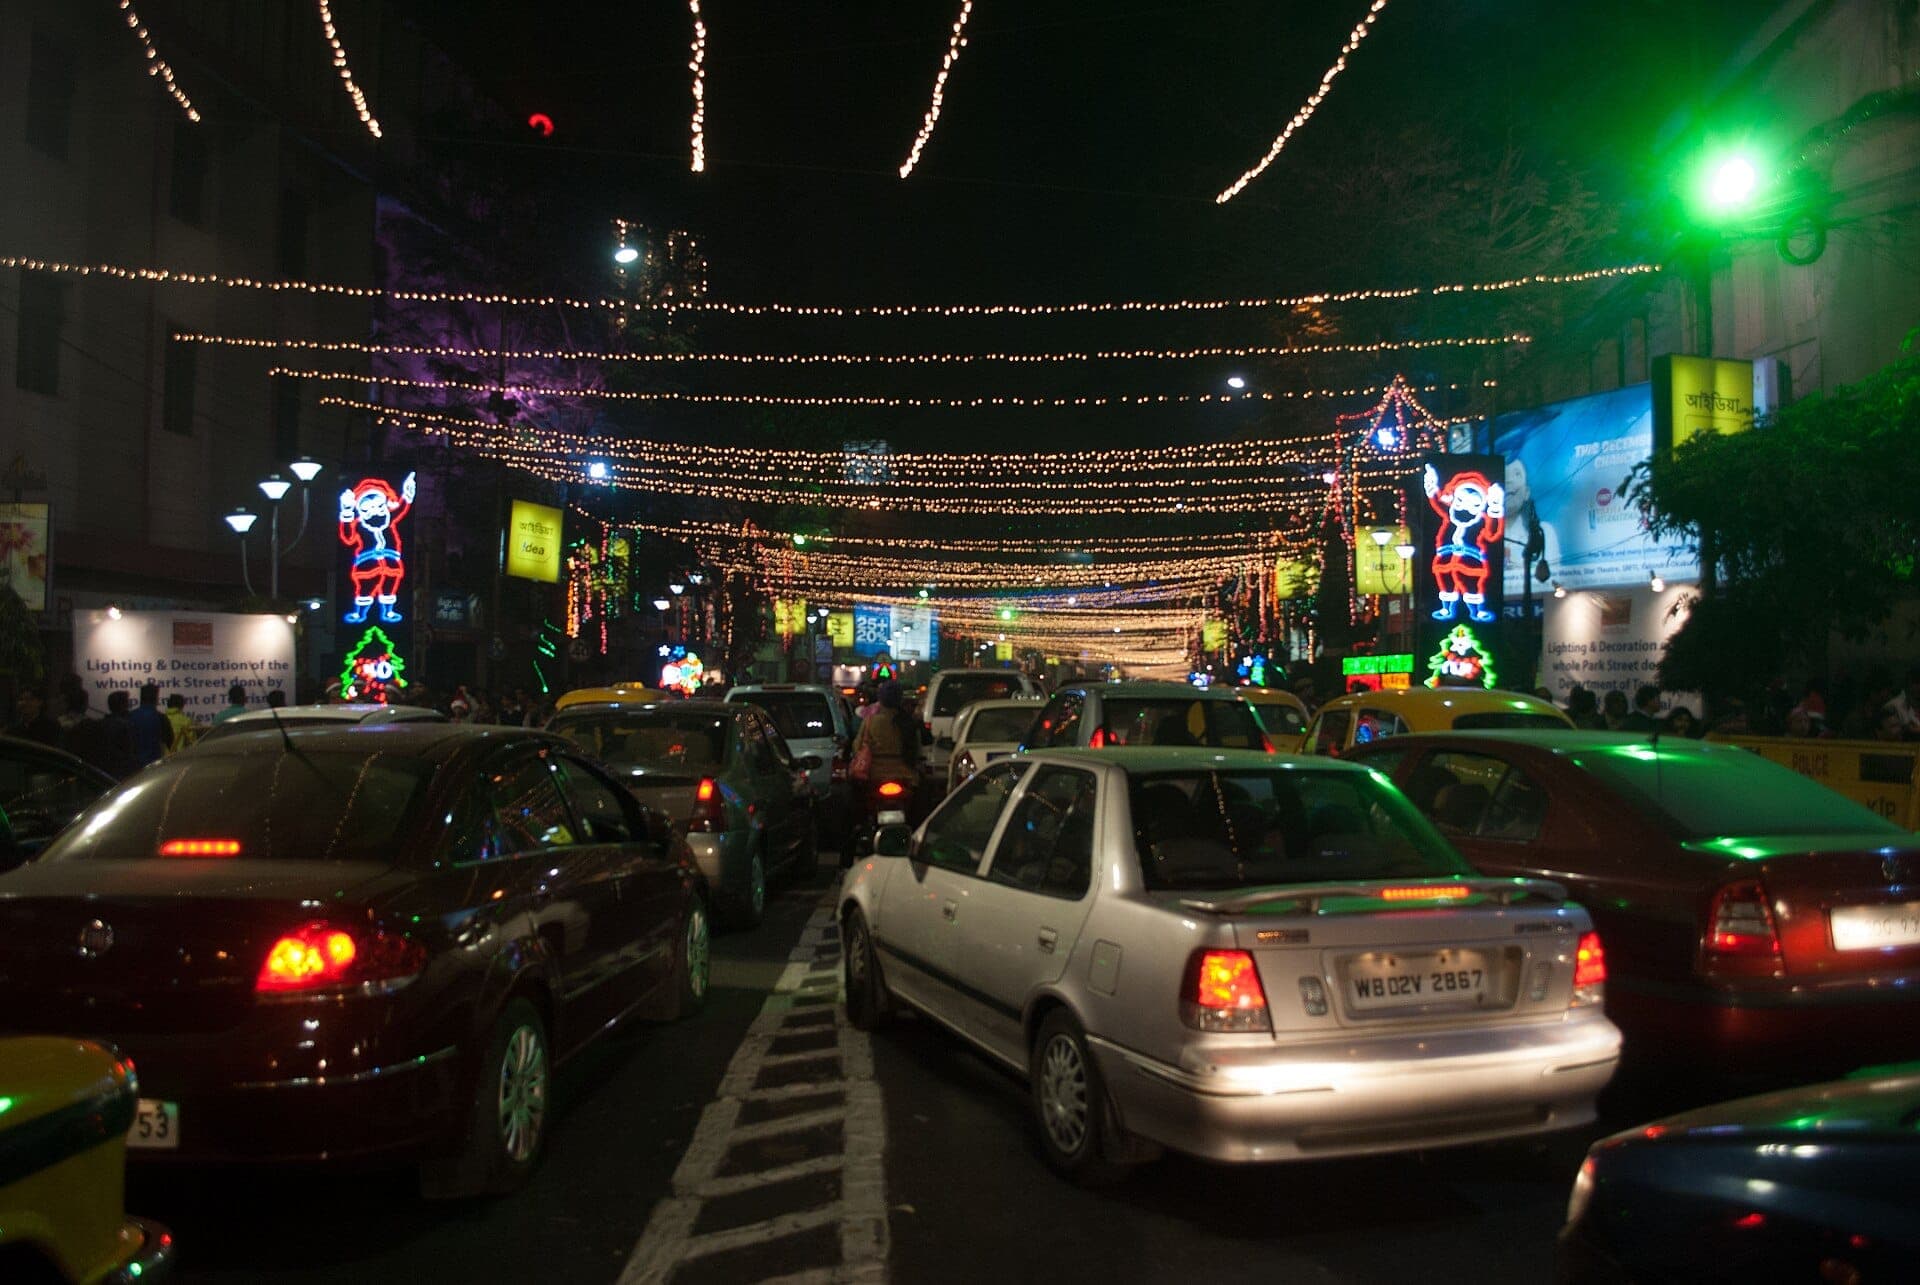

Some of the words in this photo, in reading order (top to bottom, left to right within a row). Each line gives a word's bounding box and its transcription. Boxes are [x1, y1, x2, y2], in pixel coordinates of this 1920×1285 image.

[1548, 642, 1587, 656] Lighting
[1600, 638, 1657, 651] Decoration
[87, 659, 152, 674] Lighting
[156, 660, 167, 671] &
[171, 659, 247, 671] Decoration
[252, 659, 265, 671] of
[268, 658, 289, 670] the
[1553, 660, 1580, 672] whole
[1582, 660, 1604, 672] Park
[1607, 658, 1638, 672] Street
[96, 678, 142, 689] whole
[148, 677, 180, 688] Park
[184, 676, 226, 688] Street
[231, 676, 264, 688] done
[268, 675, 284, 688] by
[1621, 679, 1630, 690] of
[203, 692, 216, 705] of
[1792, 752, 1829, 775] POLICE
[138, 1110, 169, 1139] 53
